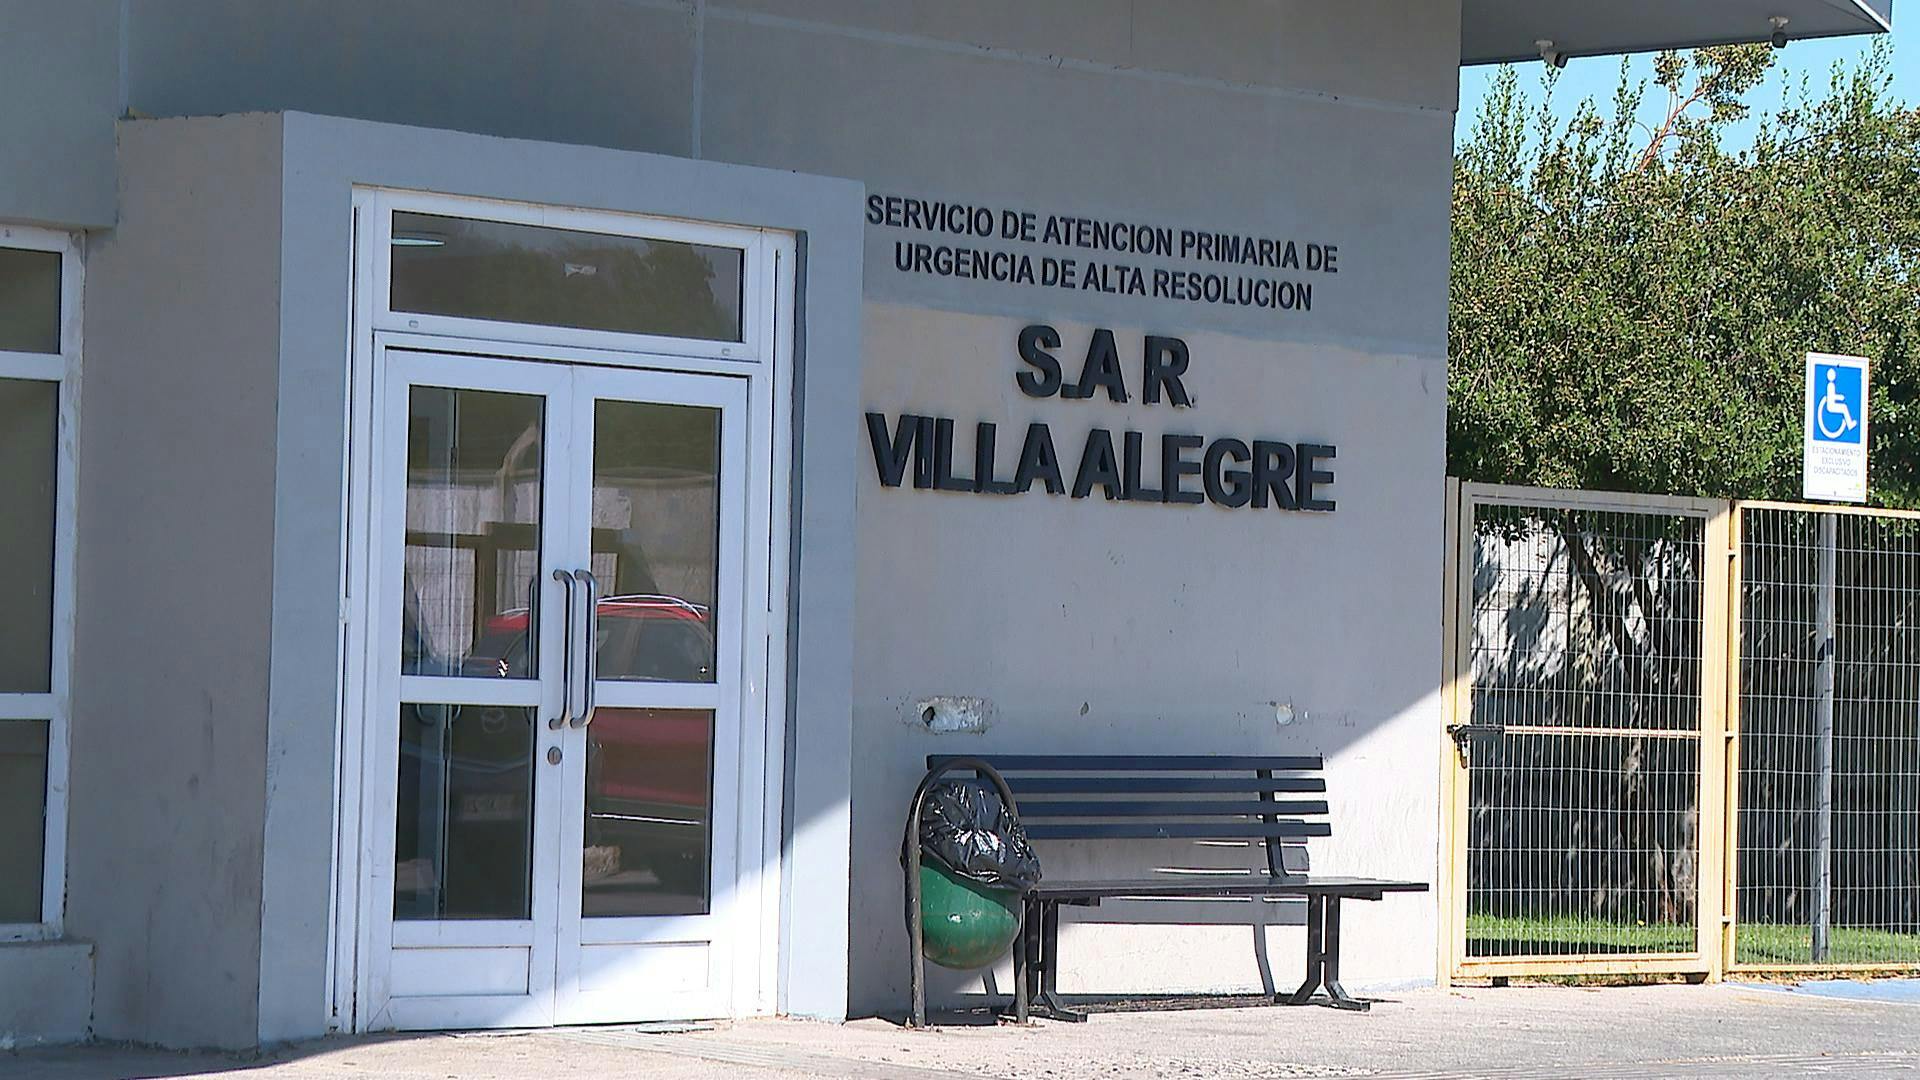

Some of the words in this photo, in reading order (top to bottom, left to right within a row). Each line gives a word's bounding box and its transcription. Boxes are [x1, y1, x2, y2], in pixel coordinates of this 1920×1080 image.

[866, 194, 993, 237] SERVICIO
[1002, 210, 1036, 243] DE
[1043, 216, 1172, 257] ATENCION
[1181, 230, 1299, 270] PRIMARIA
[1306, 243, 1338, 273] DE
[895, 241, 1034, 284] URGENCIA
[1042, 256, 1076, 289] DE
[1082, 262, 1146, 297] ALTA
[1153, 268, 1312, 311] RESOLUCION
[865, 412, 1066, 495] VILLA
[1071, 428, 1337, 512] ALEGRE
